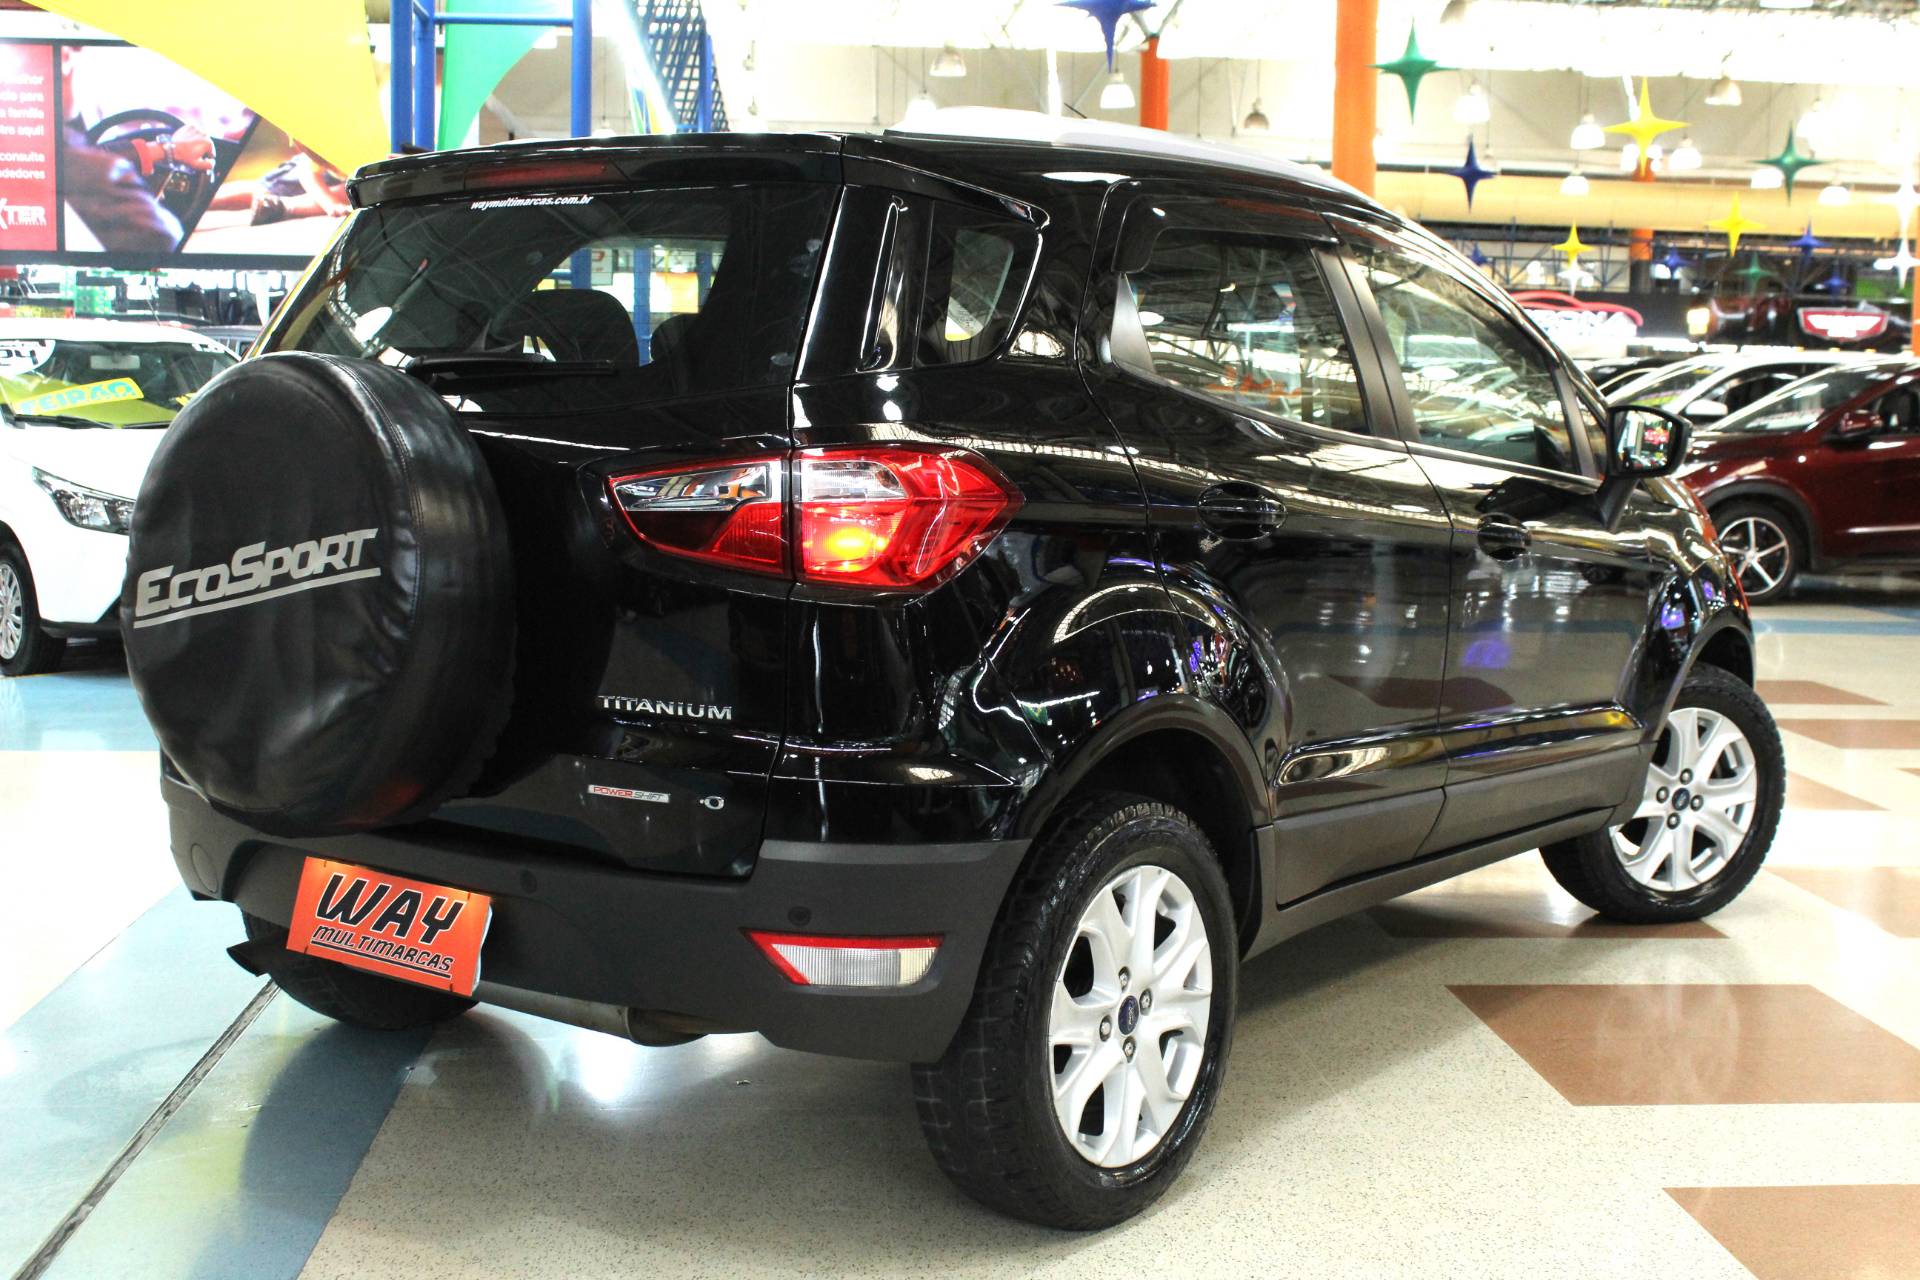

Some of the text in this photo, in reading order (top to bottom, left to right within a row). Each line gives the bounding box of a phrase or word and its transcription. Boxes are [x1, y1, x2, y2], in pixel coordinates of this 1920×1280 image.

[471, 194, 594, 211] waymultimarcas.com.br
[598, 695, 732, 720] TITANIUM
[315, 872, 468, 945] WAY
[312, 924, 455, 972] MULTIMARCAS
